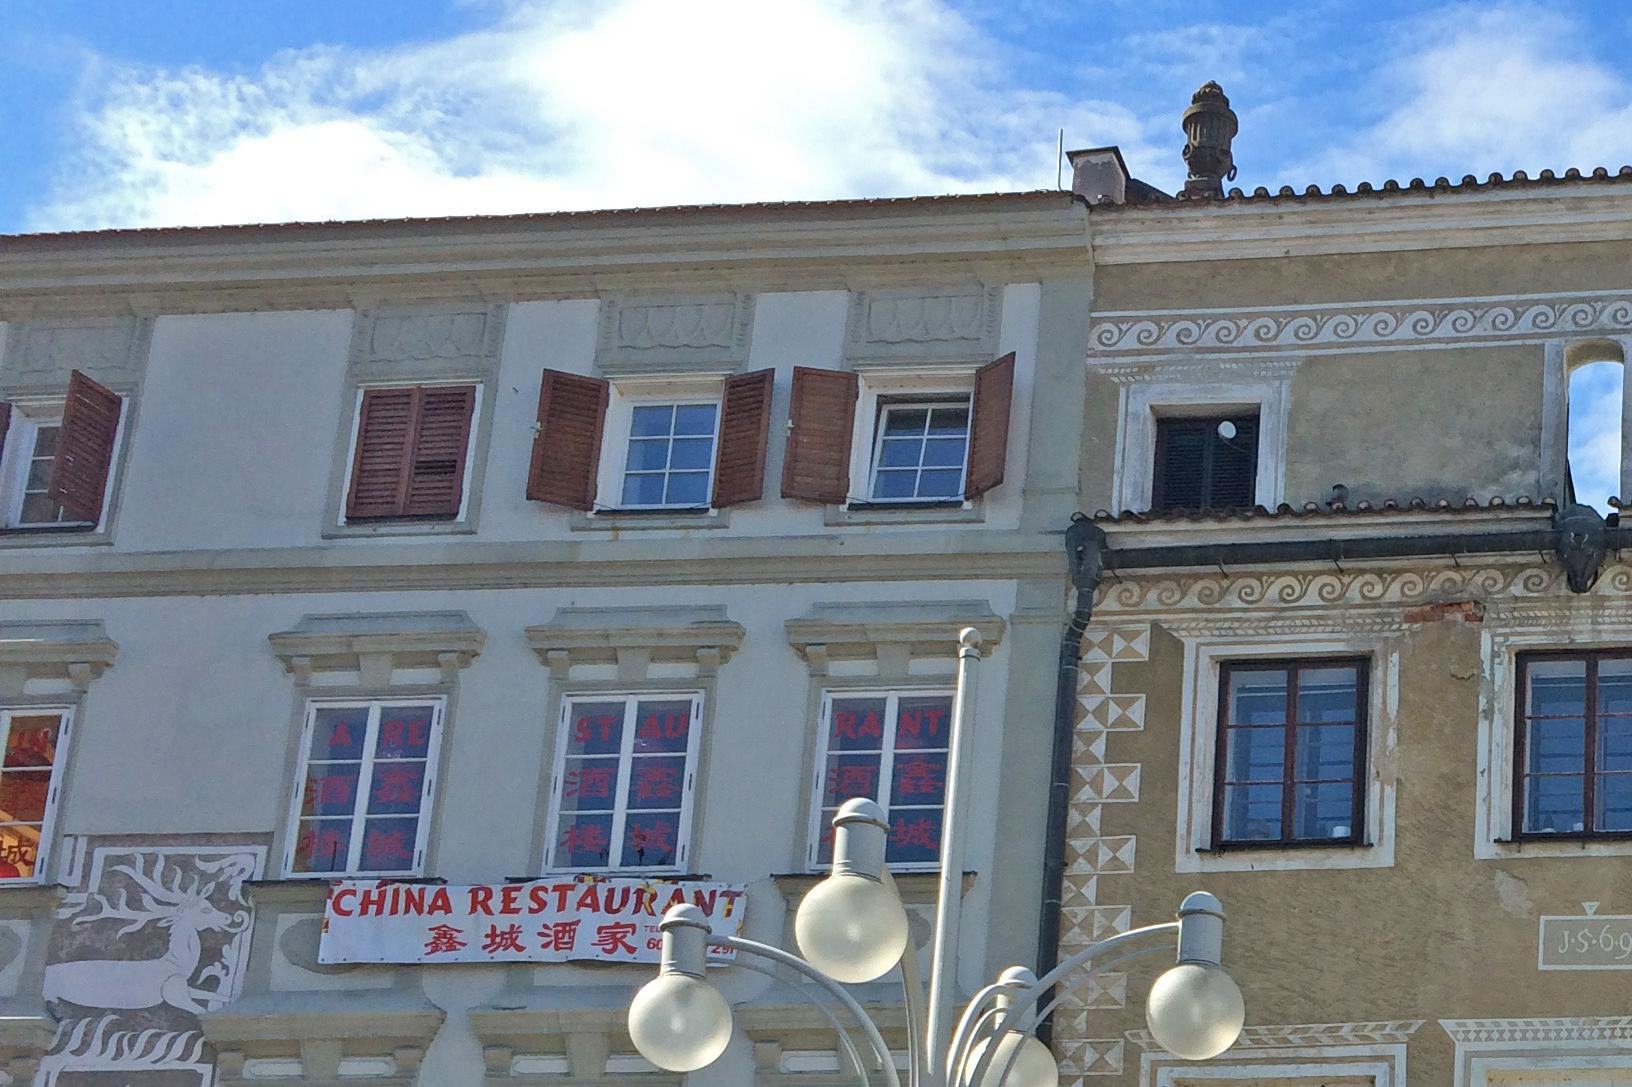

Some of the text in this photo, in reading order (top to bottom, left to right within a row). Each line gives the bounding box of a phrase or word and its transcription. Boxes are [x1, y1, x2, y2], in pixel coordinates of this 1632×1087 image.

[331, 884, 744, 918] CHINA RESTAURANT
[424, 919, 638, 955] 鑫城酒家
